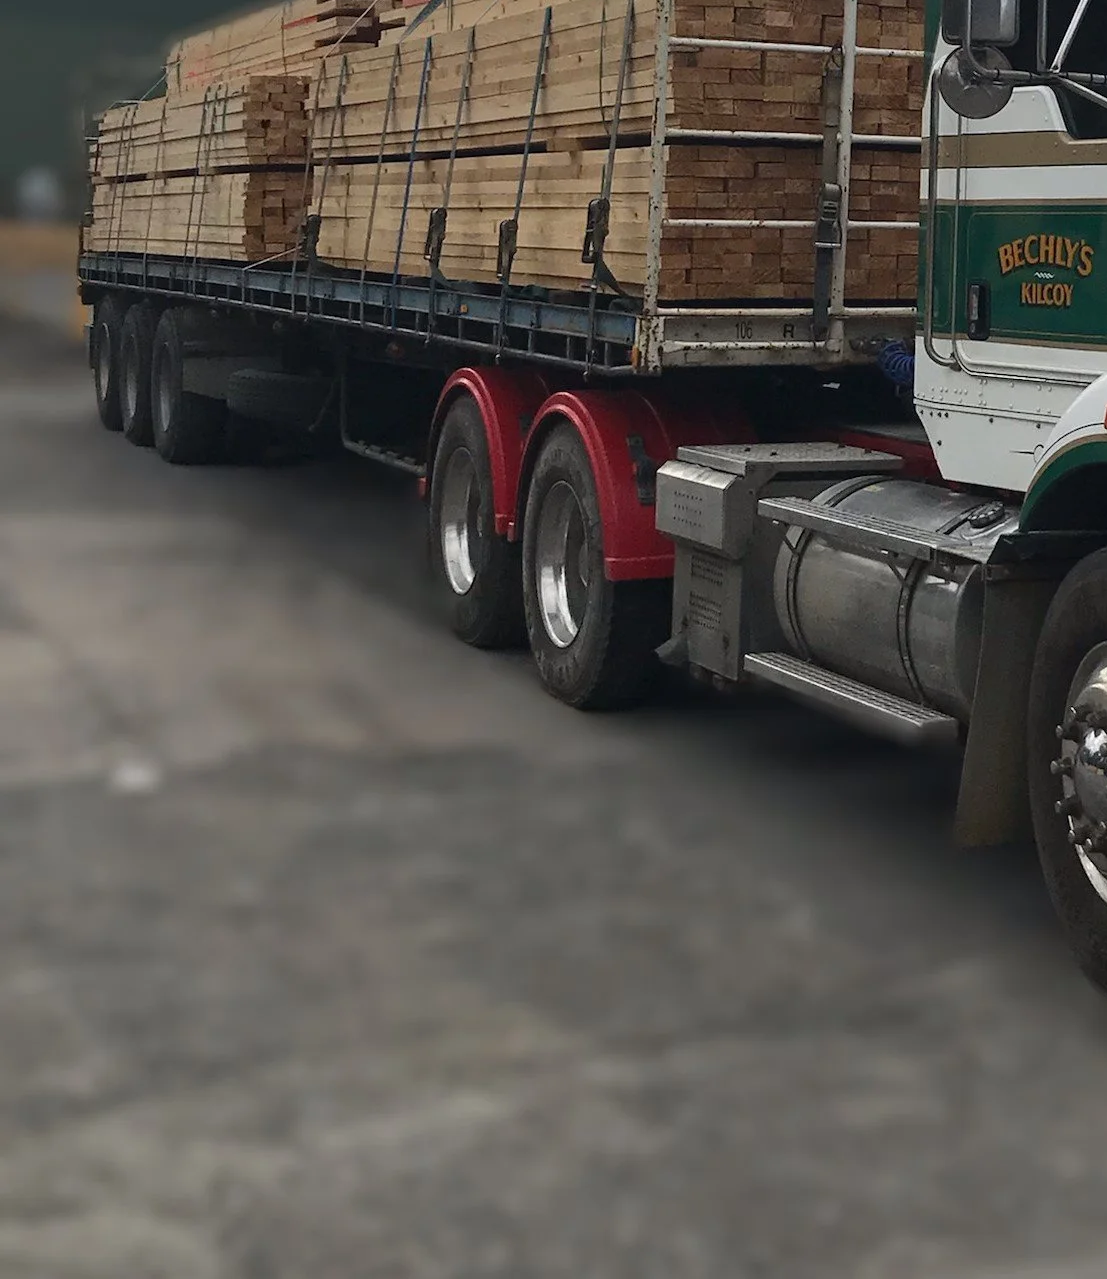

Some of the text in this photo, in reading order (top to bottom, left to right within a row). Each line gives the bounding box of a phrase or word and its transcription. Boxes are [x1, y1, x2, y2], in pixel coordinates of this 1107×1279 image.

[998, 233, 1094, 276] BECHLY'S
[1021, 282, 1073, 306] KILCOY
[735, 321, 753, 339] 106
